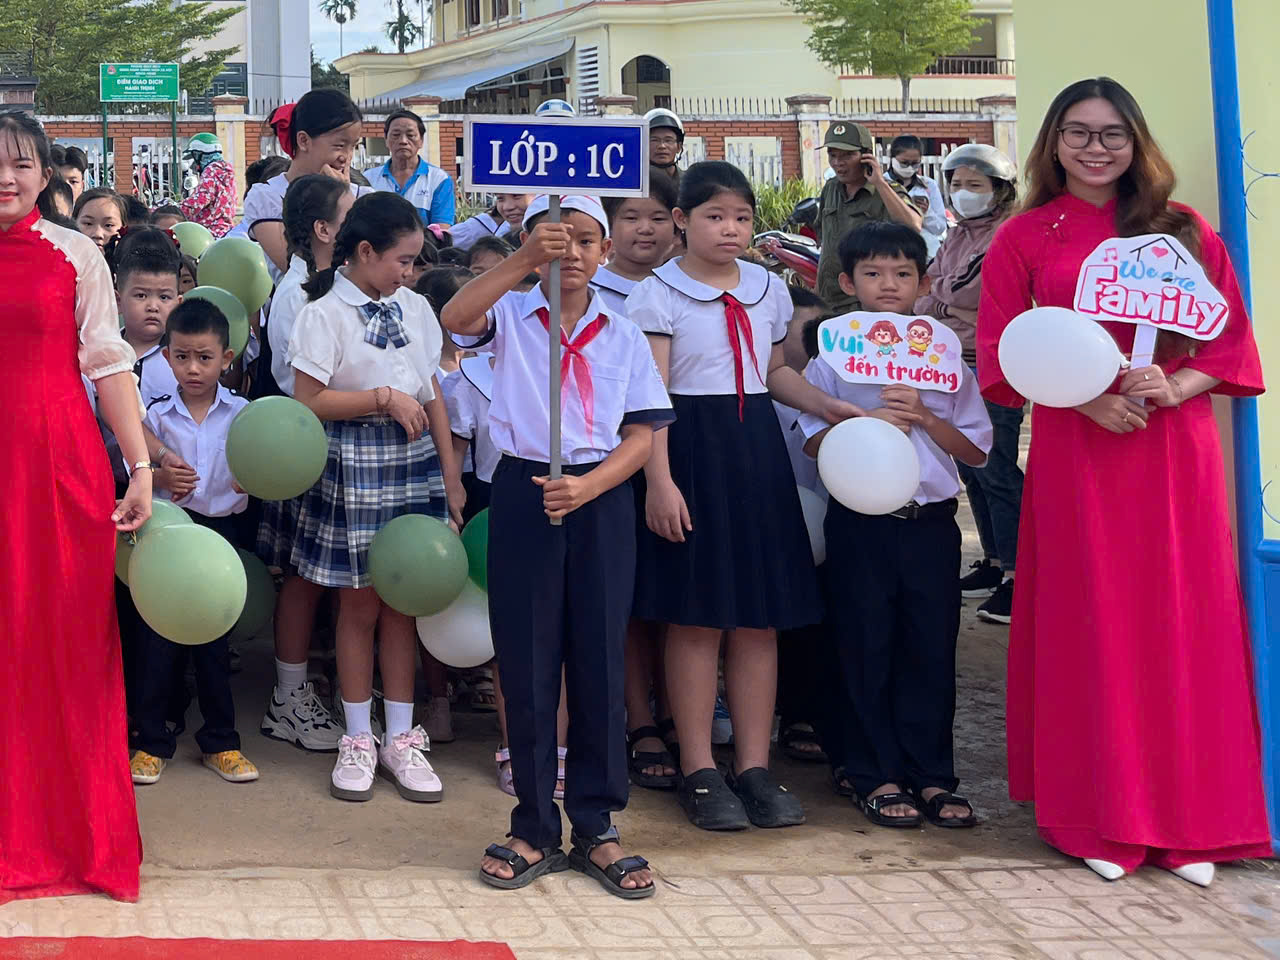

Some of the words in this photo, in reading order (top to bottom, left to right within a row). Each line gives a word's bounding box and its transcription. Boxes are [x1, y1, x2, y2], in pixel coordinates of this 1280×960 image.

[489, 130, 558, 176] LỚP
[586, 143, 625, 179] 1C
[1120, 260, 1159, 280] We
[822, 327, 864, 355] Vui
[844, 355, 879, 377] đến
[885, 361, 958, 391] trường
